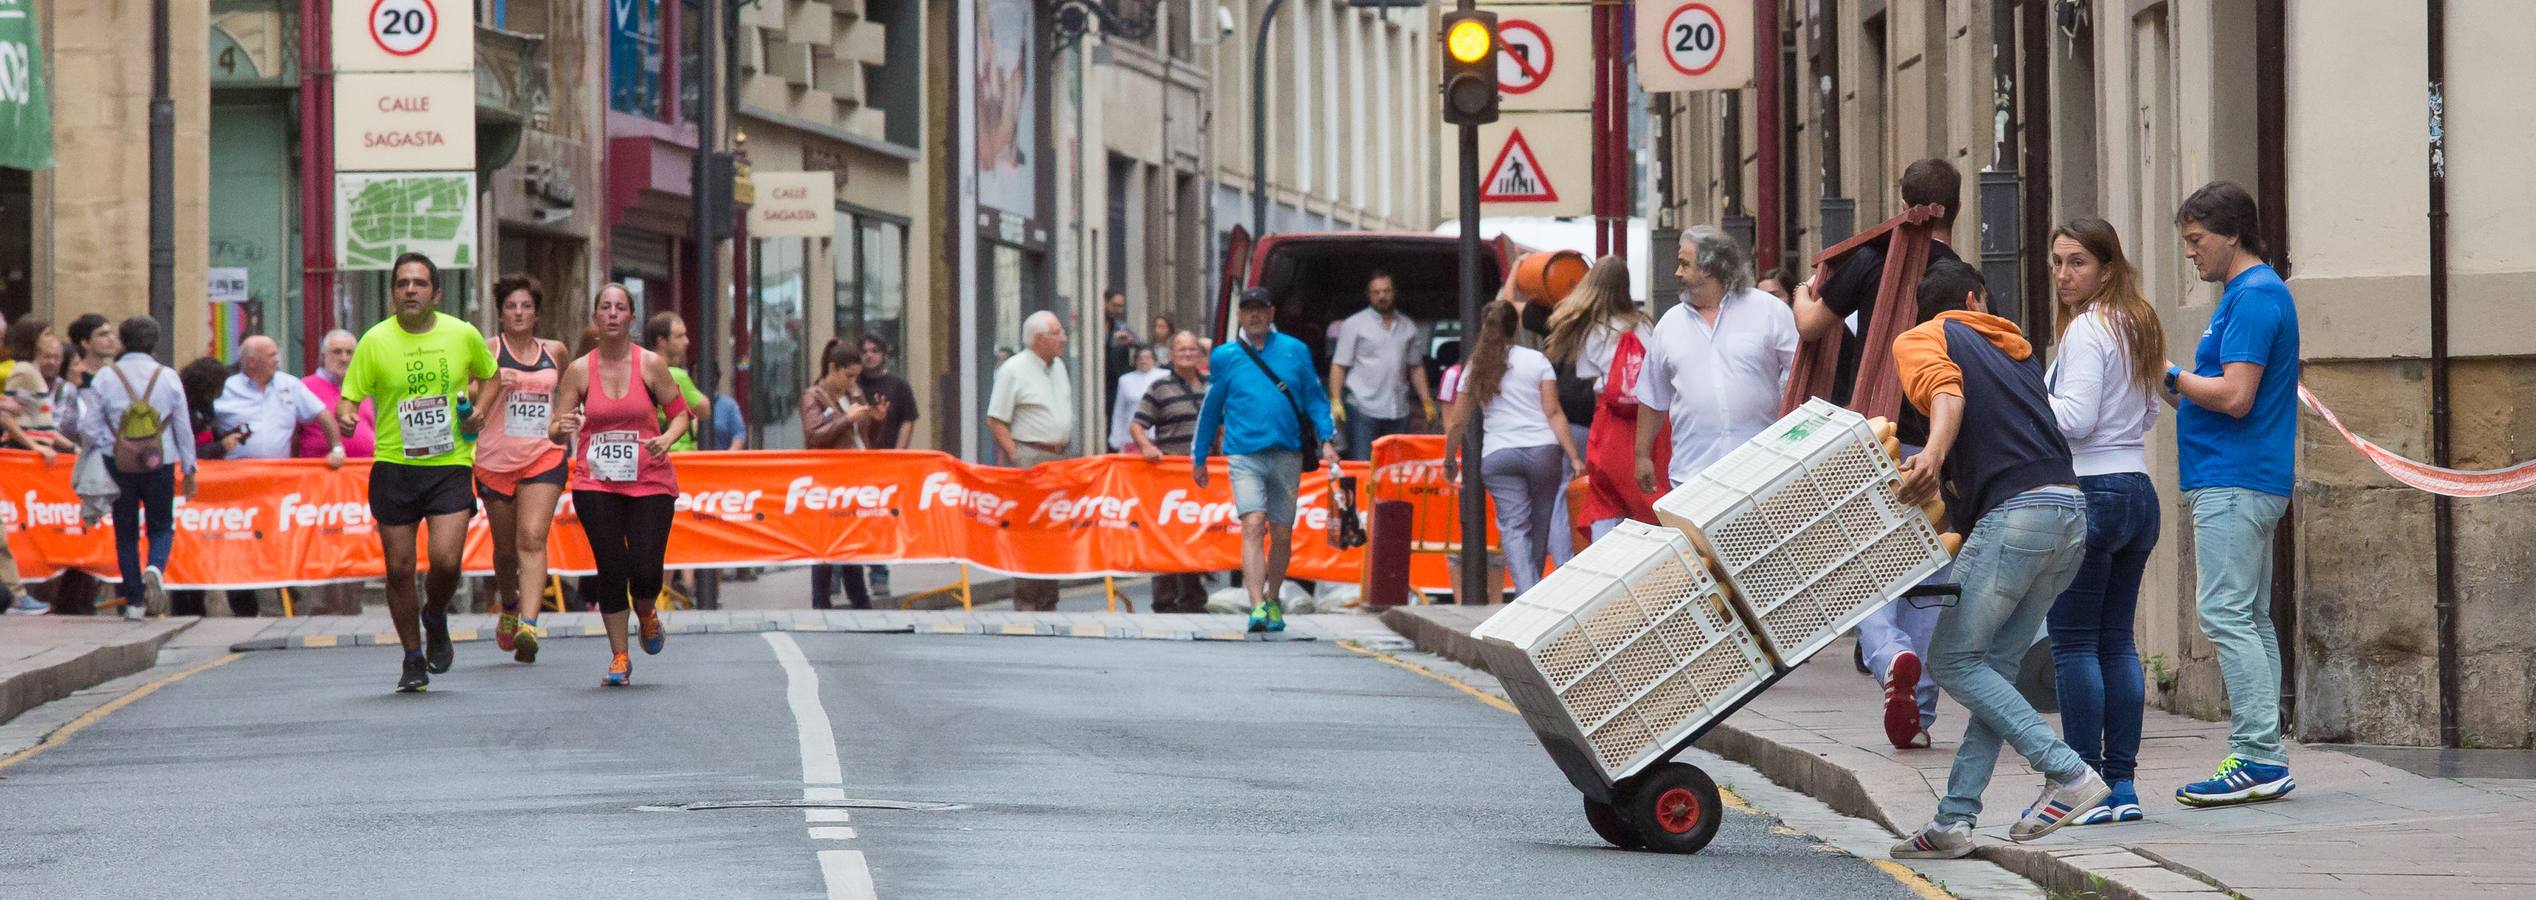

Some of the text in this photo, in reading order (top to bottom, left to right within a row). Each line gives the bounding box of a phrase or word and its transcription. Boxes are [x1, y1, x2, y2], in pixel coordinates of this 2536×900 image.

[383, 9, 424, 35] 20
[1675, 23, 1714, 51] 20
[378, 96, 430, 112] CALLE
[363, 131, 444, 148] SAGASTA
[772, 187, 807, 199] CALLE
[764, 210, 816, 220] SAGASTA
[406, 361, 423, 372] LO
[407, 372, 436, 384] GRO
[404, 409, 446, 427] 1455
[510, 404, 546, 417] 1422
[594, 445, 633, 459] 1456
[784, 476, 897, 515] ferrer
